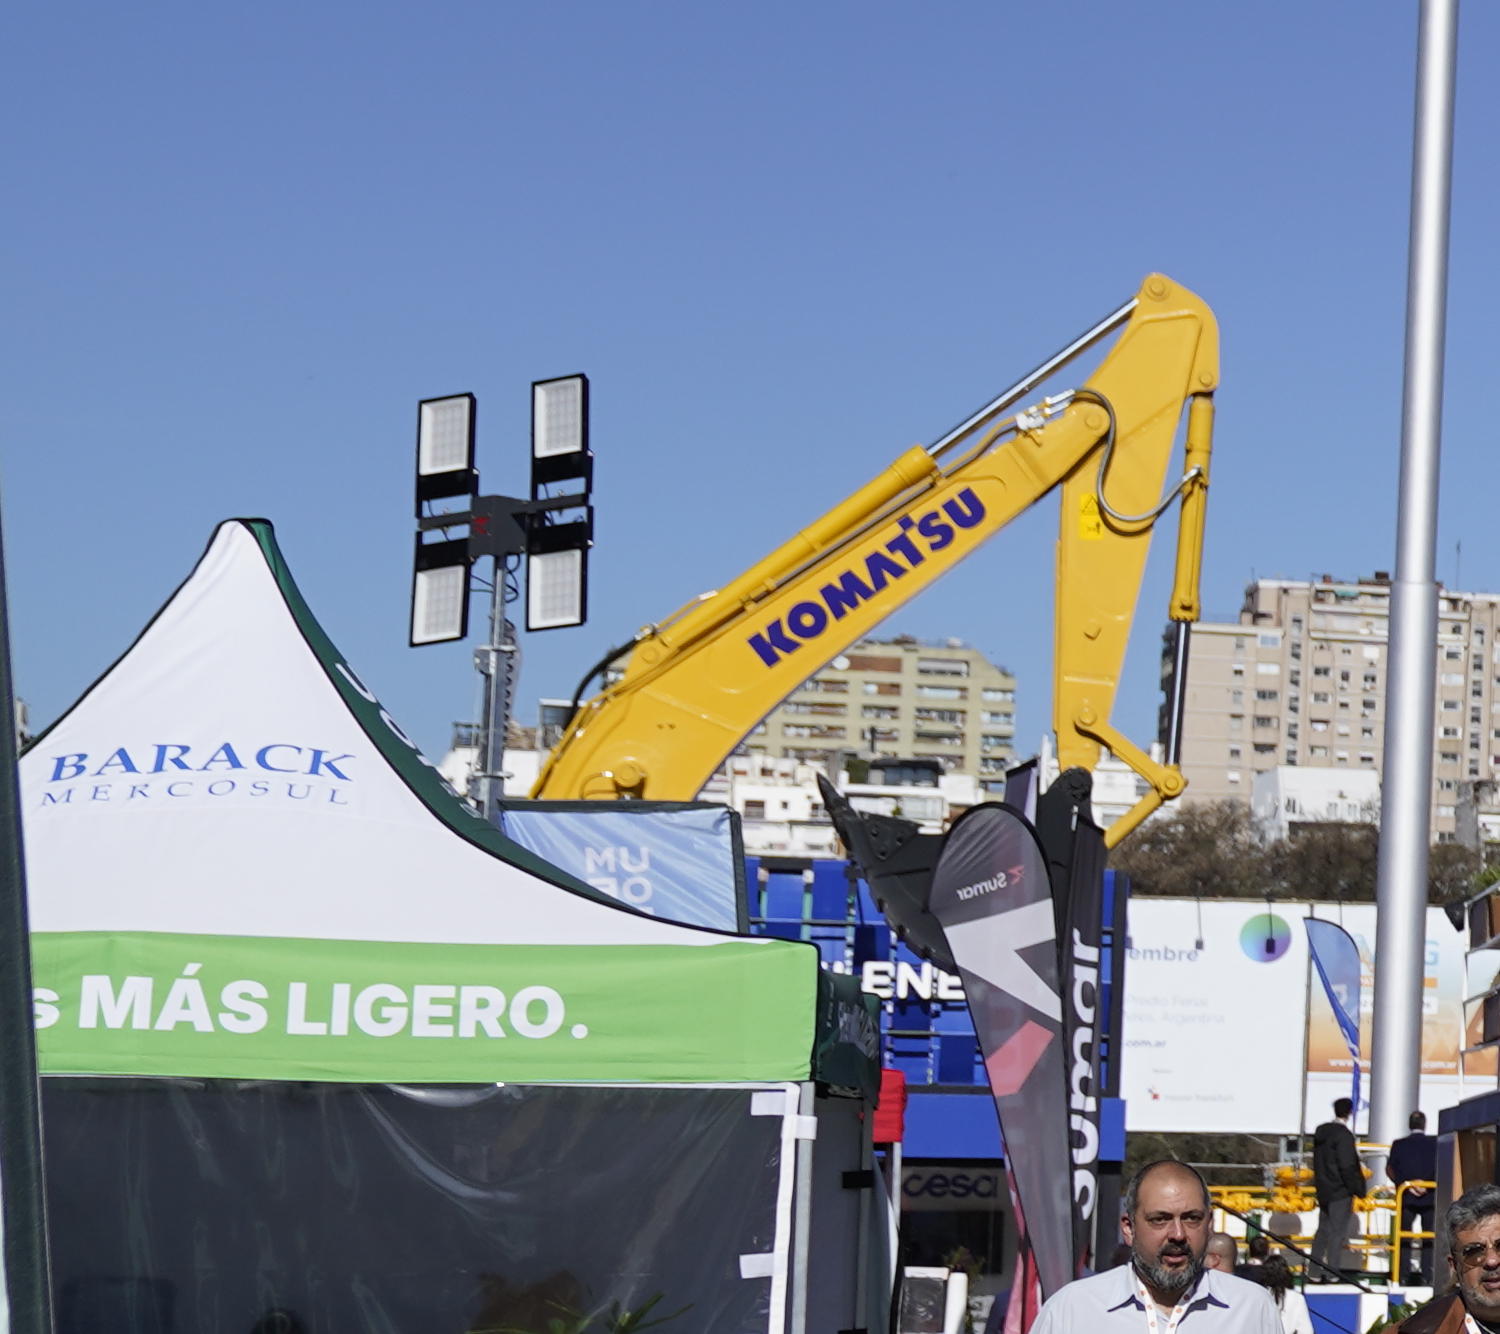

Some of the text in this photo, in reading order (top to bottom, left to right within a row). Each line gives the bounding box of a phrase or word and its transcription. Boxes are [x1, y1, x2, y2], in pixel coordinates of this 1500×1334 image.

[748, 487, 986, 668] KOMATSU
[49, 744, 354, 782] BARACK
[41, 781, 349, 806] MERCOSUL
[1129, 946, 1199, 962] embre
[79, 964, 268, 1033] MÁS
[288, 983, 588, 1040] LIGERO.
[1071, 928, 1099, 1221] sumar
